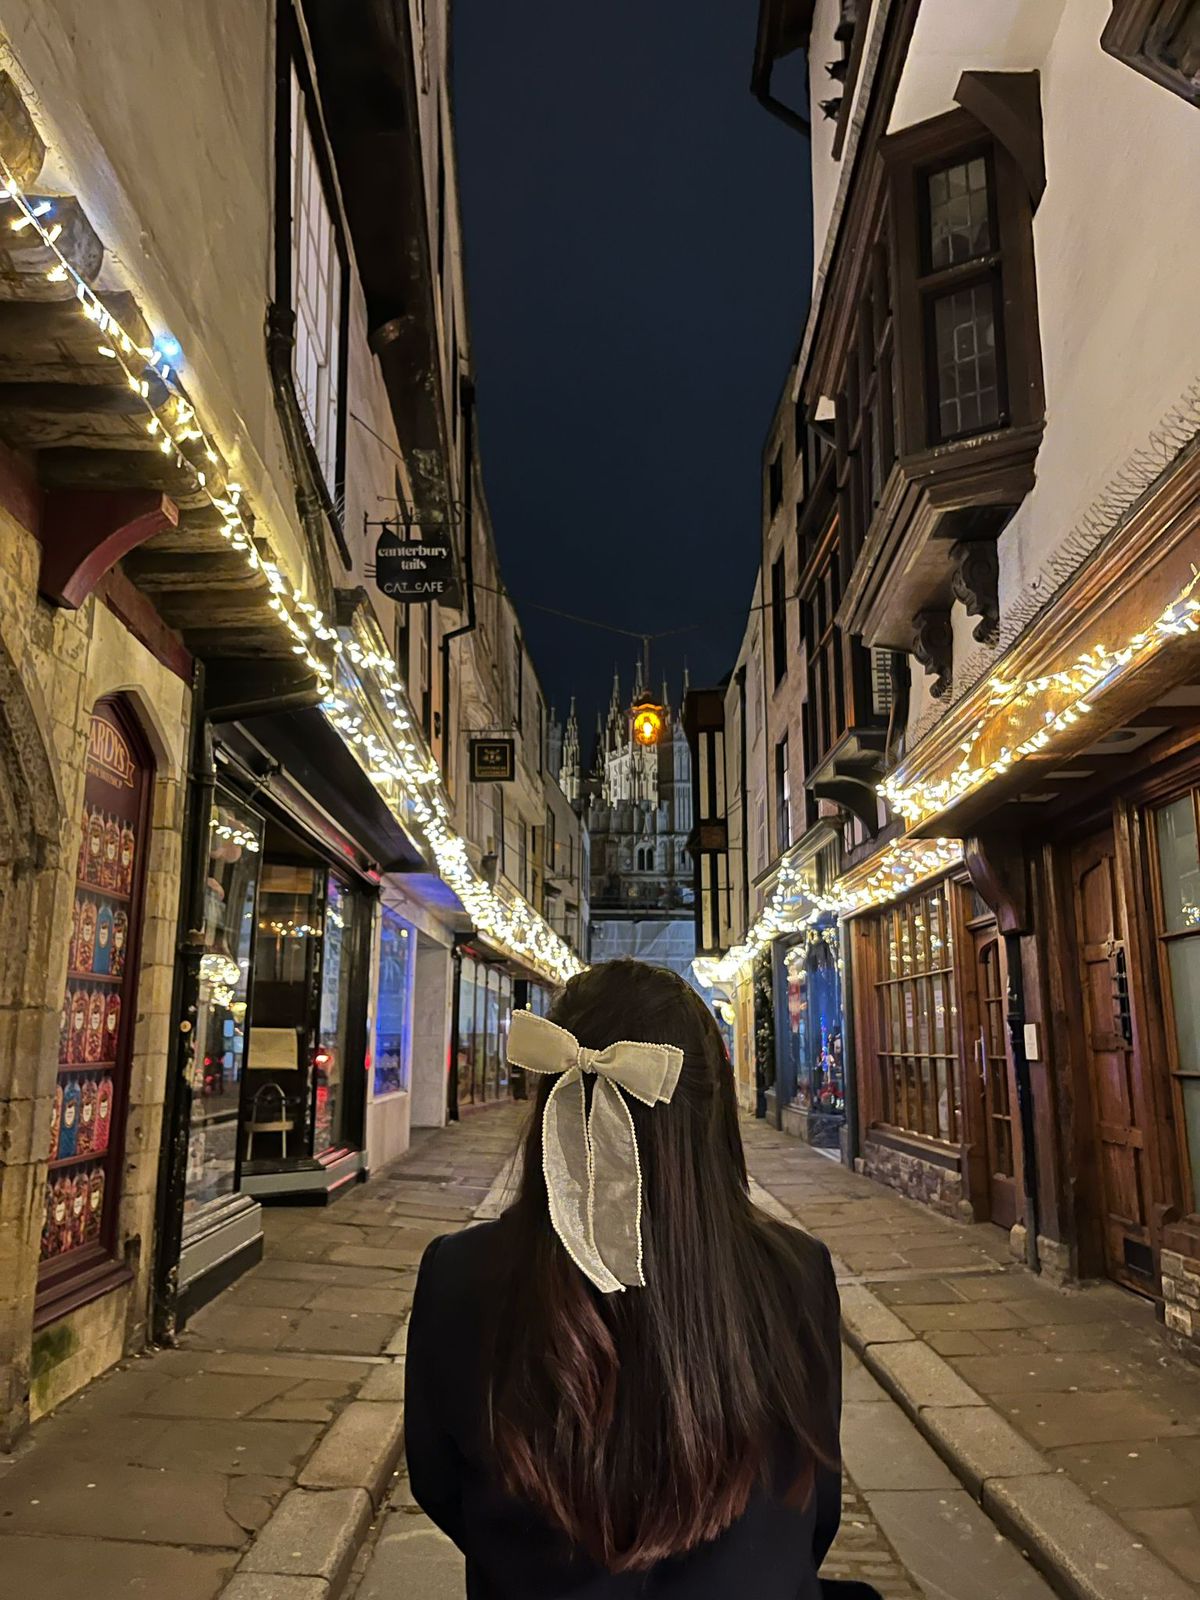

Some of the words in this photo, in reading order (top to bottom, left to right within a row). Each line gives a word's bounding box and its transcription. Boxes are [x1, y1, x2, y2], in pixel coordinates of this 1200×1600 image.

[378, 545, 448, 559] canterbury
[401, 558, 427, 570] tails
[384, 582, 408, 593] CAT
[415, 581, 444, 593] CAFE
[87, 720, 125, 772] ARDYS
